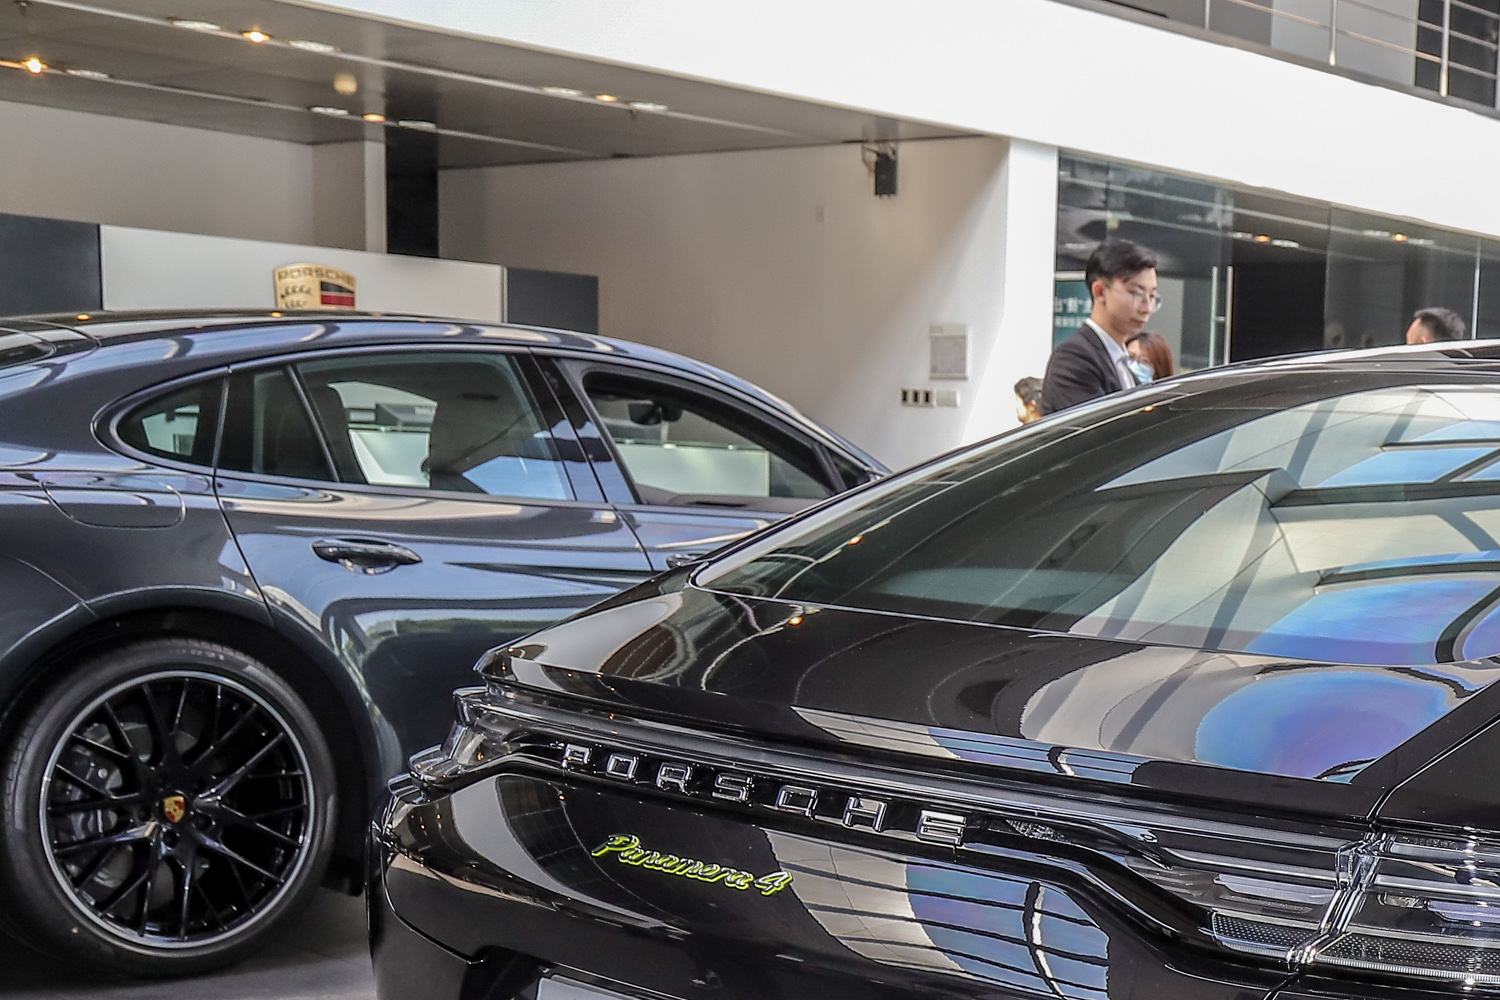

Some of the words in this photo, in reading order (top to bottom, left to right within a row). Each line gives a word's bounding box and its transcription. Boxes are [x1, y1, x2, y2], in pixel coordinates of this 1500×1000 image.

[278, 267, 355, 285] PORSCHE
[561, 743, 968, 847] PORSCHE
[591, 833, 753, 890] Panamera
[753, 868, 795, 897] 4
